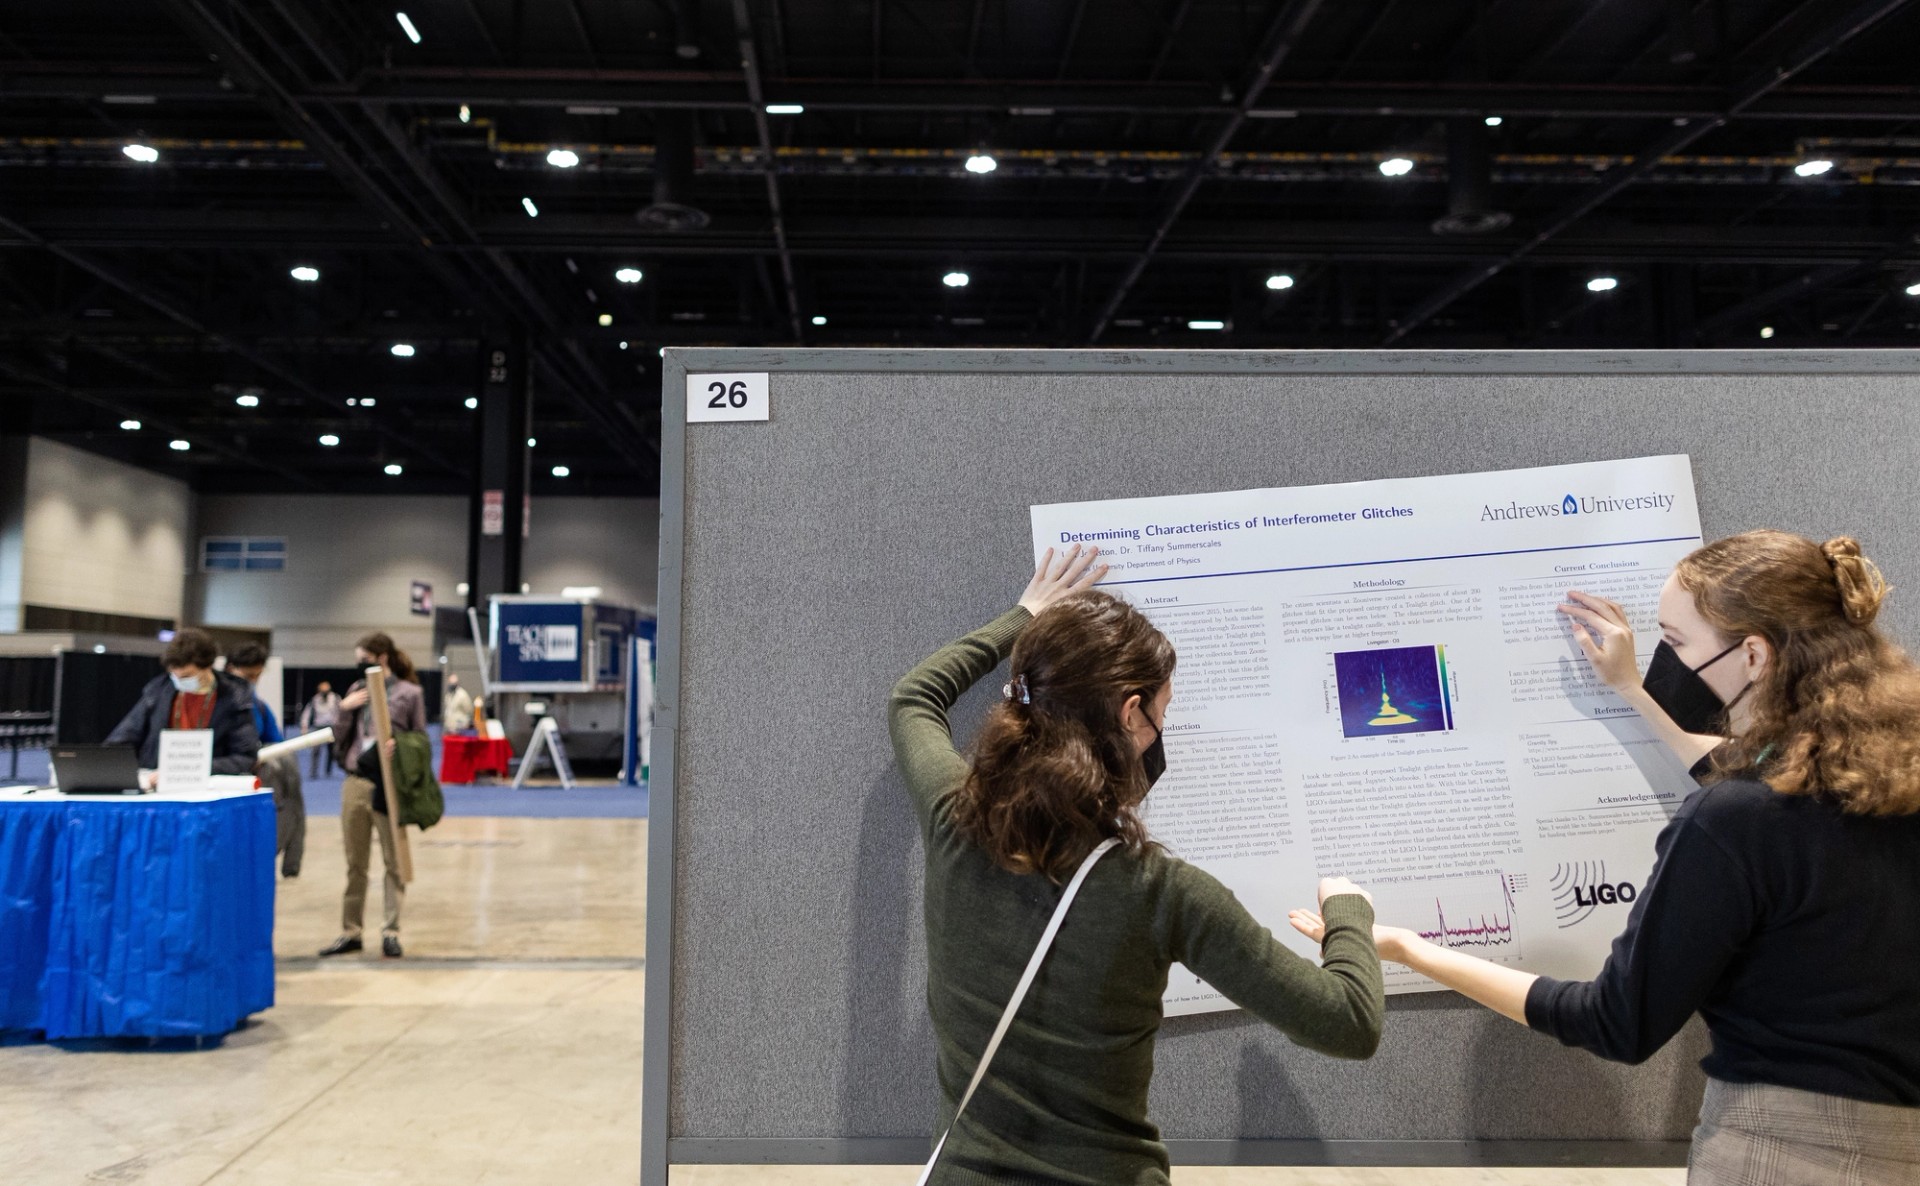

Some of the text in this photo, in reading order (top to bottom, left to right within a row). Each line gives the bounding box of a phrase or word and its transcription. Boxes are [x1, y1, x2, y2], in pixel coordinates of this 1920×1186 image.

[708, 381, 748, 409] 26
[1480, 492, 1675, 522] Andrews University
[1060, 505, 1413, 543] Determining Characteristics of Interferometer Glitches
[1120, 546, 1133, 555] Dr.
[1138, 544, 1165, 554] Tiffany
[1167, 540, 1222, 551] Summerscales
[1127, 560, 1166, 569] Department
[1176, 557, 1201, 566] Physics
[1554, 560, 1640, 573] Current Conclusions
[1353, 578, 1406, 589] Methodology
[1144, 595, 1179, 604] Abstract
[1161, 723, 1201, 732] roduction
[1597, 792, 1677, 805] Acknowledgements
[1574, 882, 1636, 906] LIGO
